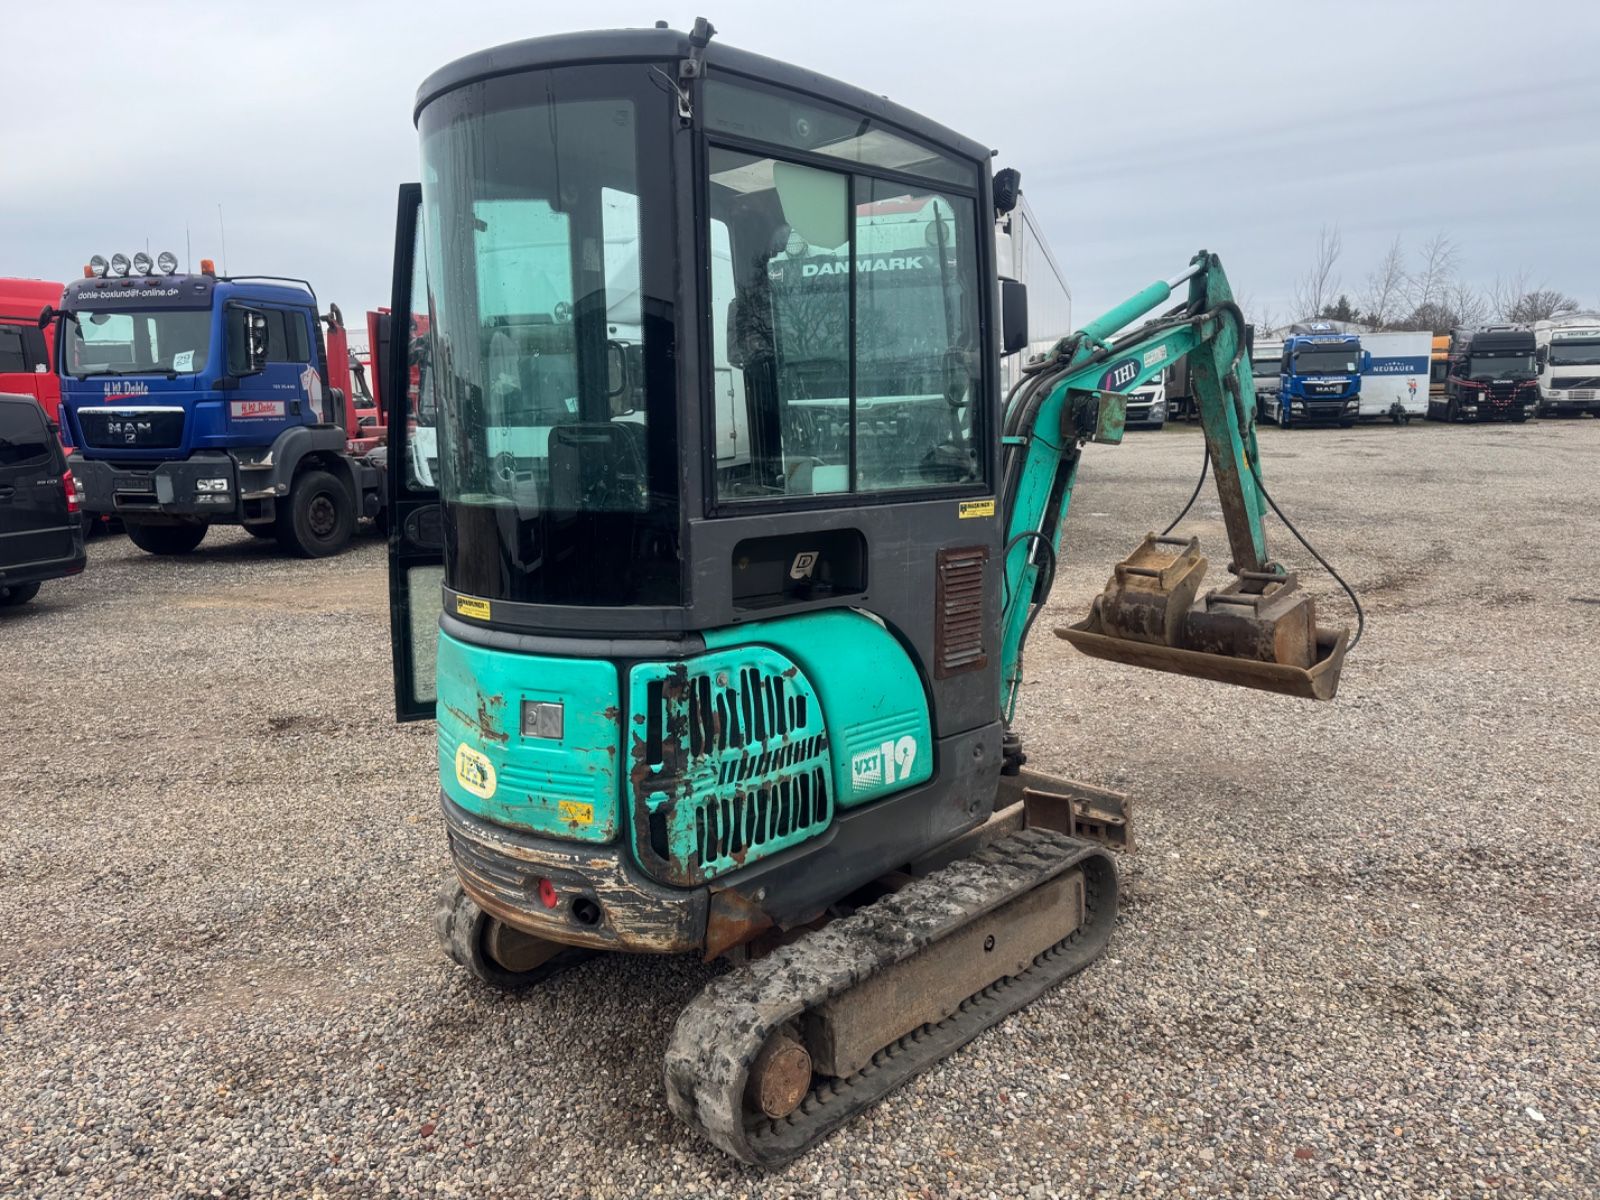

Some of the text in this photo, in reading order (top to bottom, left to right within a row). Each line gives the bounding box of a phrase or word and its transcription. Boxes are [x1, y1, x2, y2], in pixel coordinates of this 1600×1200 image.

[802, 256, 923, 278] DANMARK
[1114, 362, 1136, 387] IHI
[124, 381, 149, 395] Dohle
[108, 422, 151, 434] MAN
[831, 420, 897, 436] MAN
[854, 735, 917, 785] VXT 19
